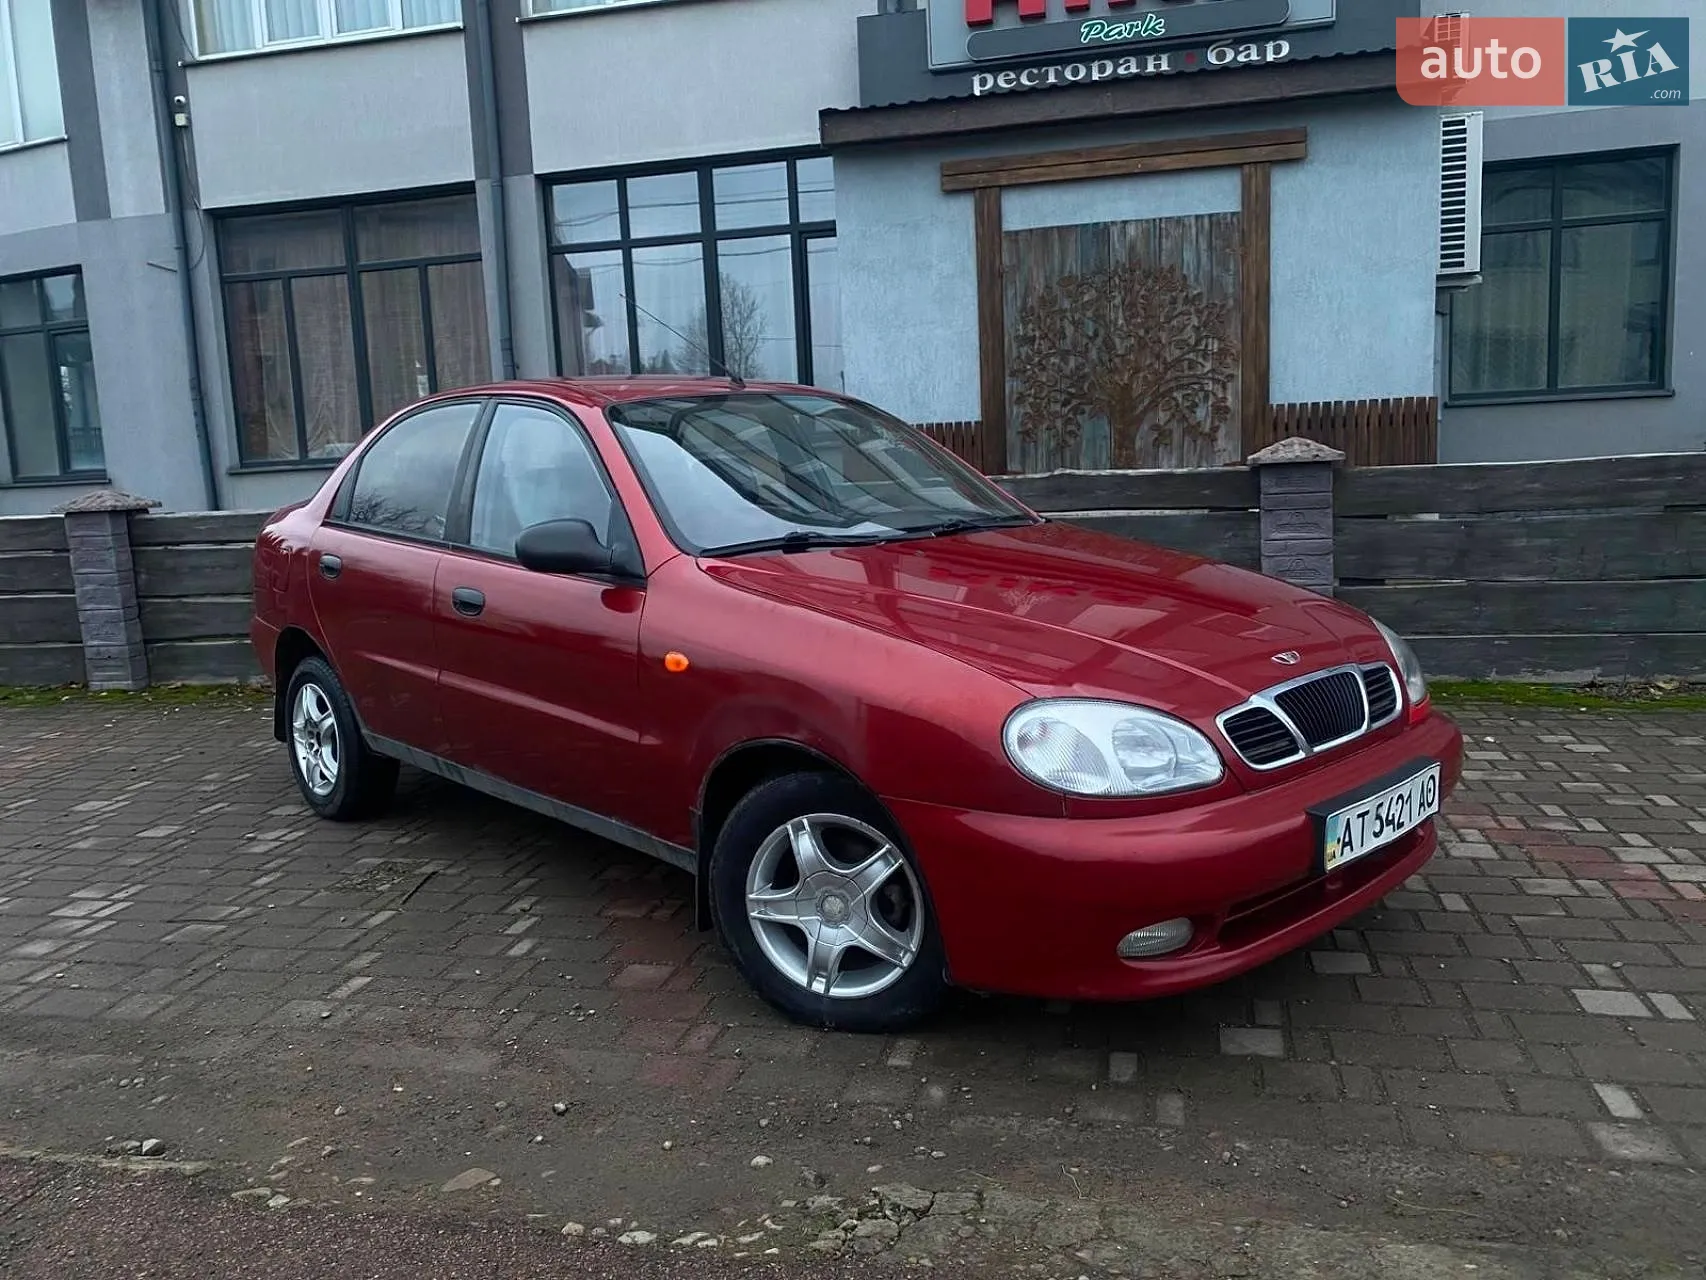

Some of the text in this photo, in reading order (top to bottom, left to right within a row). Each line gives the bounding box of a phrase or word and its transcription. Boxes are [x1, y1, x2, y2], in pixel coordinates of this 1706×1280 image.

[1081, 13, 1165, 43] Park
[971, 39, 1290, 96] ресторан бар
[1340, 809, 1370, 857] AT
[1372, 788, 1413, 838] 5421
